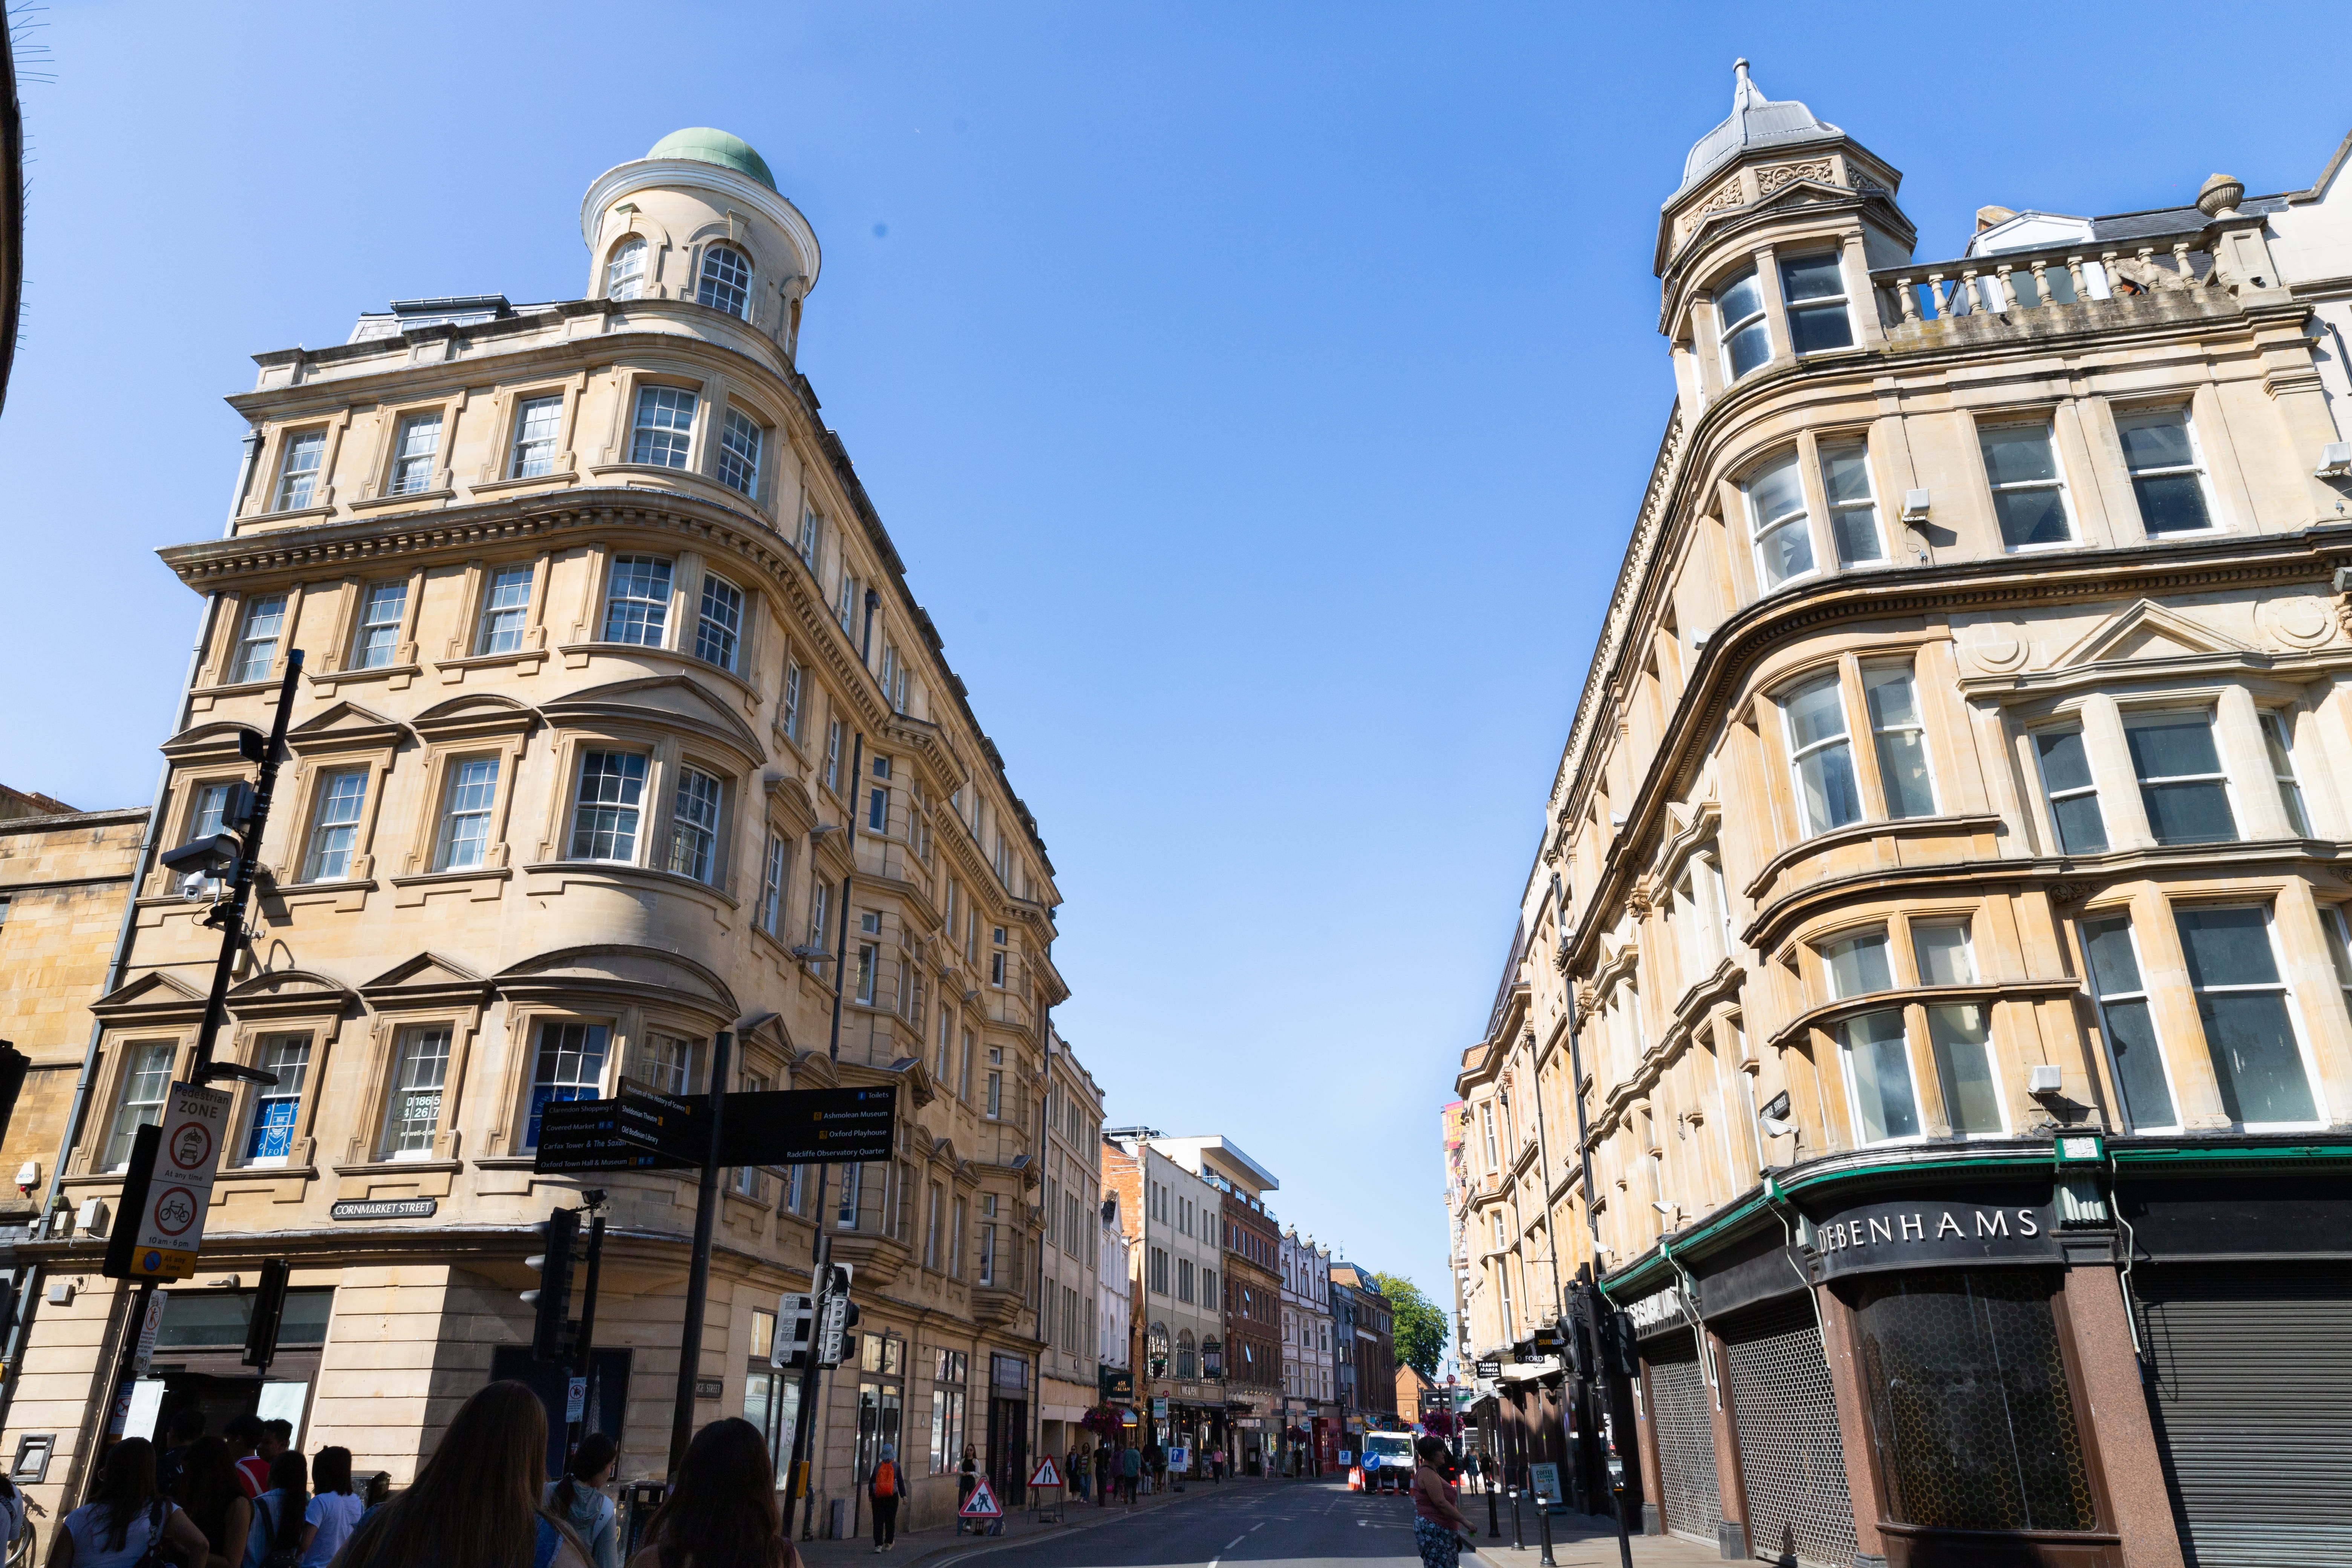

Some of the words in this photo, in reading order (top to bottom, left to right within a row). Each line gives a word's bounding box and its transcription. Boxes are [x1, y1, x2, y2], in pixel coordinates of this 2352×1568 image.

[175, 1085, 228, 1105] Pedestrian
[626, 1084, 642, 1095] Museum
[654, 1096, 667, 1107] History
[673, 1102, 685, 1112] Science
[179, 1100, 218, 1119] ZONE
[1774, 1095, 1786, 1112] STREET
[622, 1105, 642, 1117] Sheldonian
[643, 1112, 657, 1123] Theatre
[629, 1129, 645, 1138] Bodleian
[646, 1133, 658, 1145] Library
[854, 1129, 887, 1138] Playhouse
[175, 1171, 187, 1180] any
[189, 1173, 203, 1181] time
[335, 1204, 398, 1215] CORNMARKET
[398, 1202, 431, 1213] STREET
[1818, 1209, 2038, 1253] DEBENHAMS
[706, 1384, 720, 1393] STREET
[1188, 1387, 1190, 1395] &
